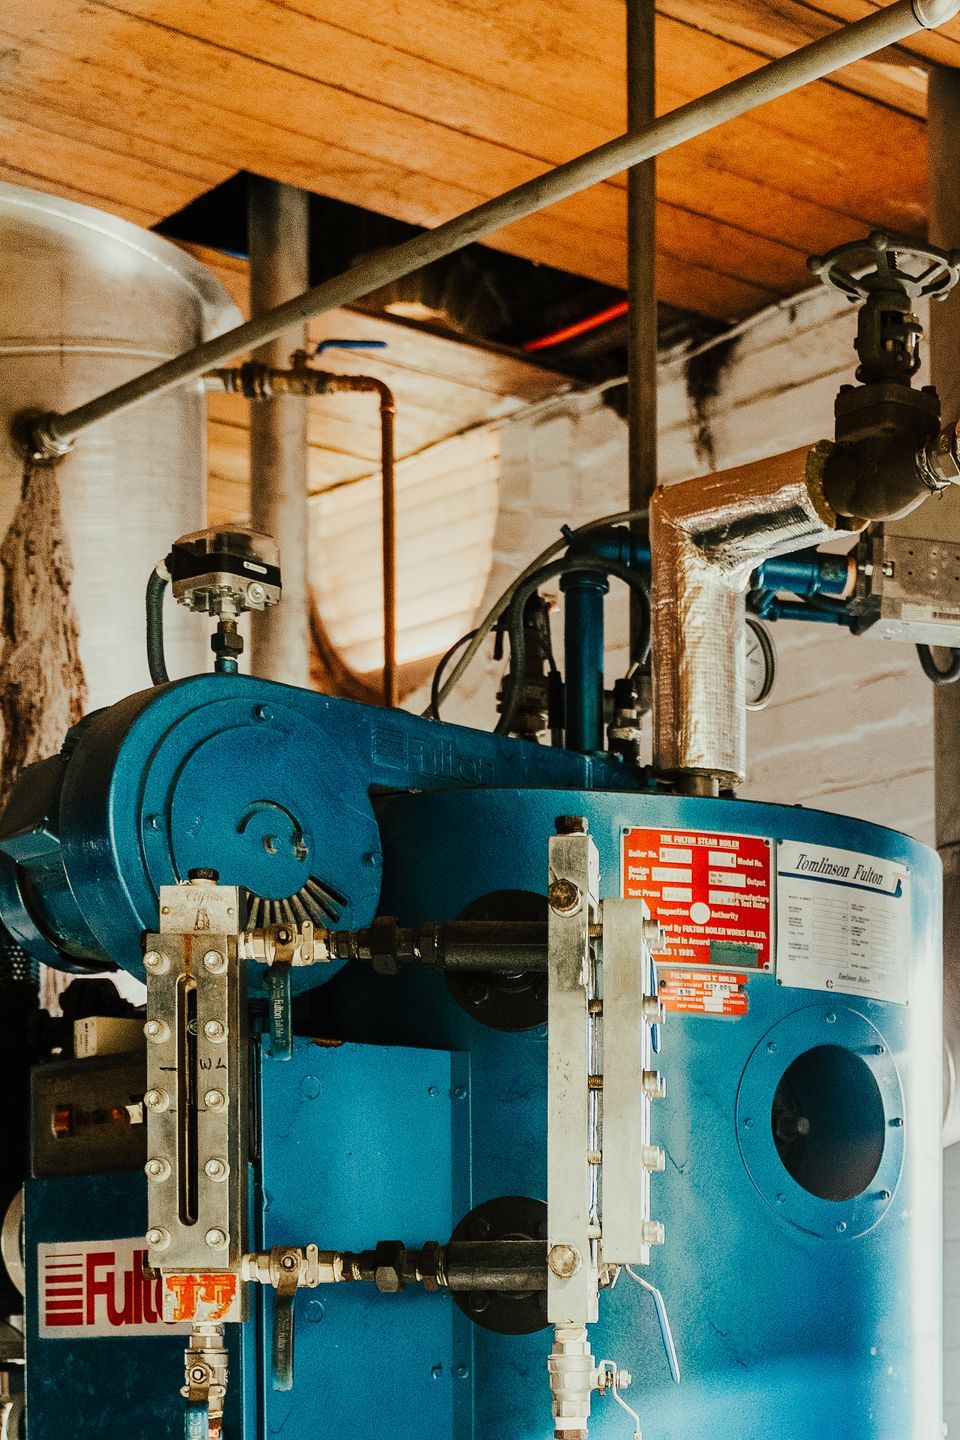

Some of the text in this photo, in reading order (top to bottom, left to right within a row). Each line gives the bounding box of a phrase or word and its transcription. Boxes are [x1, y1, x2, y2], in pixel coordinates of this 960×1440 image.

[660, 834, 740, 849] THE FULTON STEAM BOILER
[628, 849, 648, 858] Boiler
[648, 850, 659, 859] No.
[737, 857, 755, 867] Model
[755, 859, 764, 868] No.
[795, 853, 884, 886] Tomlinson Fulton
[746, 877, 767, 888] Output
[628, 888, 642, 897] Test
[642, 889, 661, 898] Press
[741, 900, 752, 908] Test
[752, 901, 767, 910] Date
[656, 906, 739, 922] Inspection Authority
[682, 925, 705, 934] FULTON
[705, 926, 726, 936] BOILER
[726, 927, 747, 938] WORKS
[273, 999, 284, 1019] Fulton
